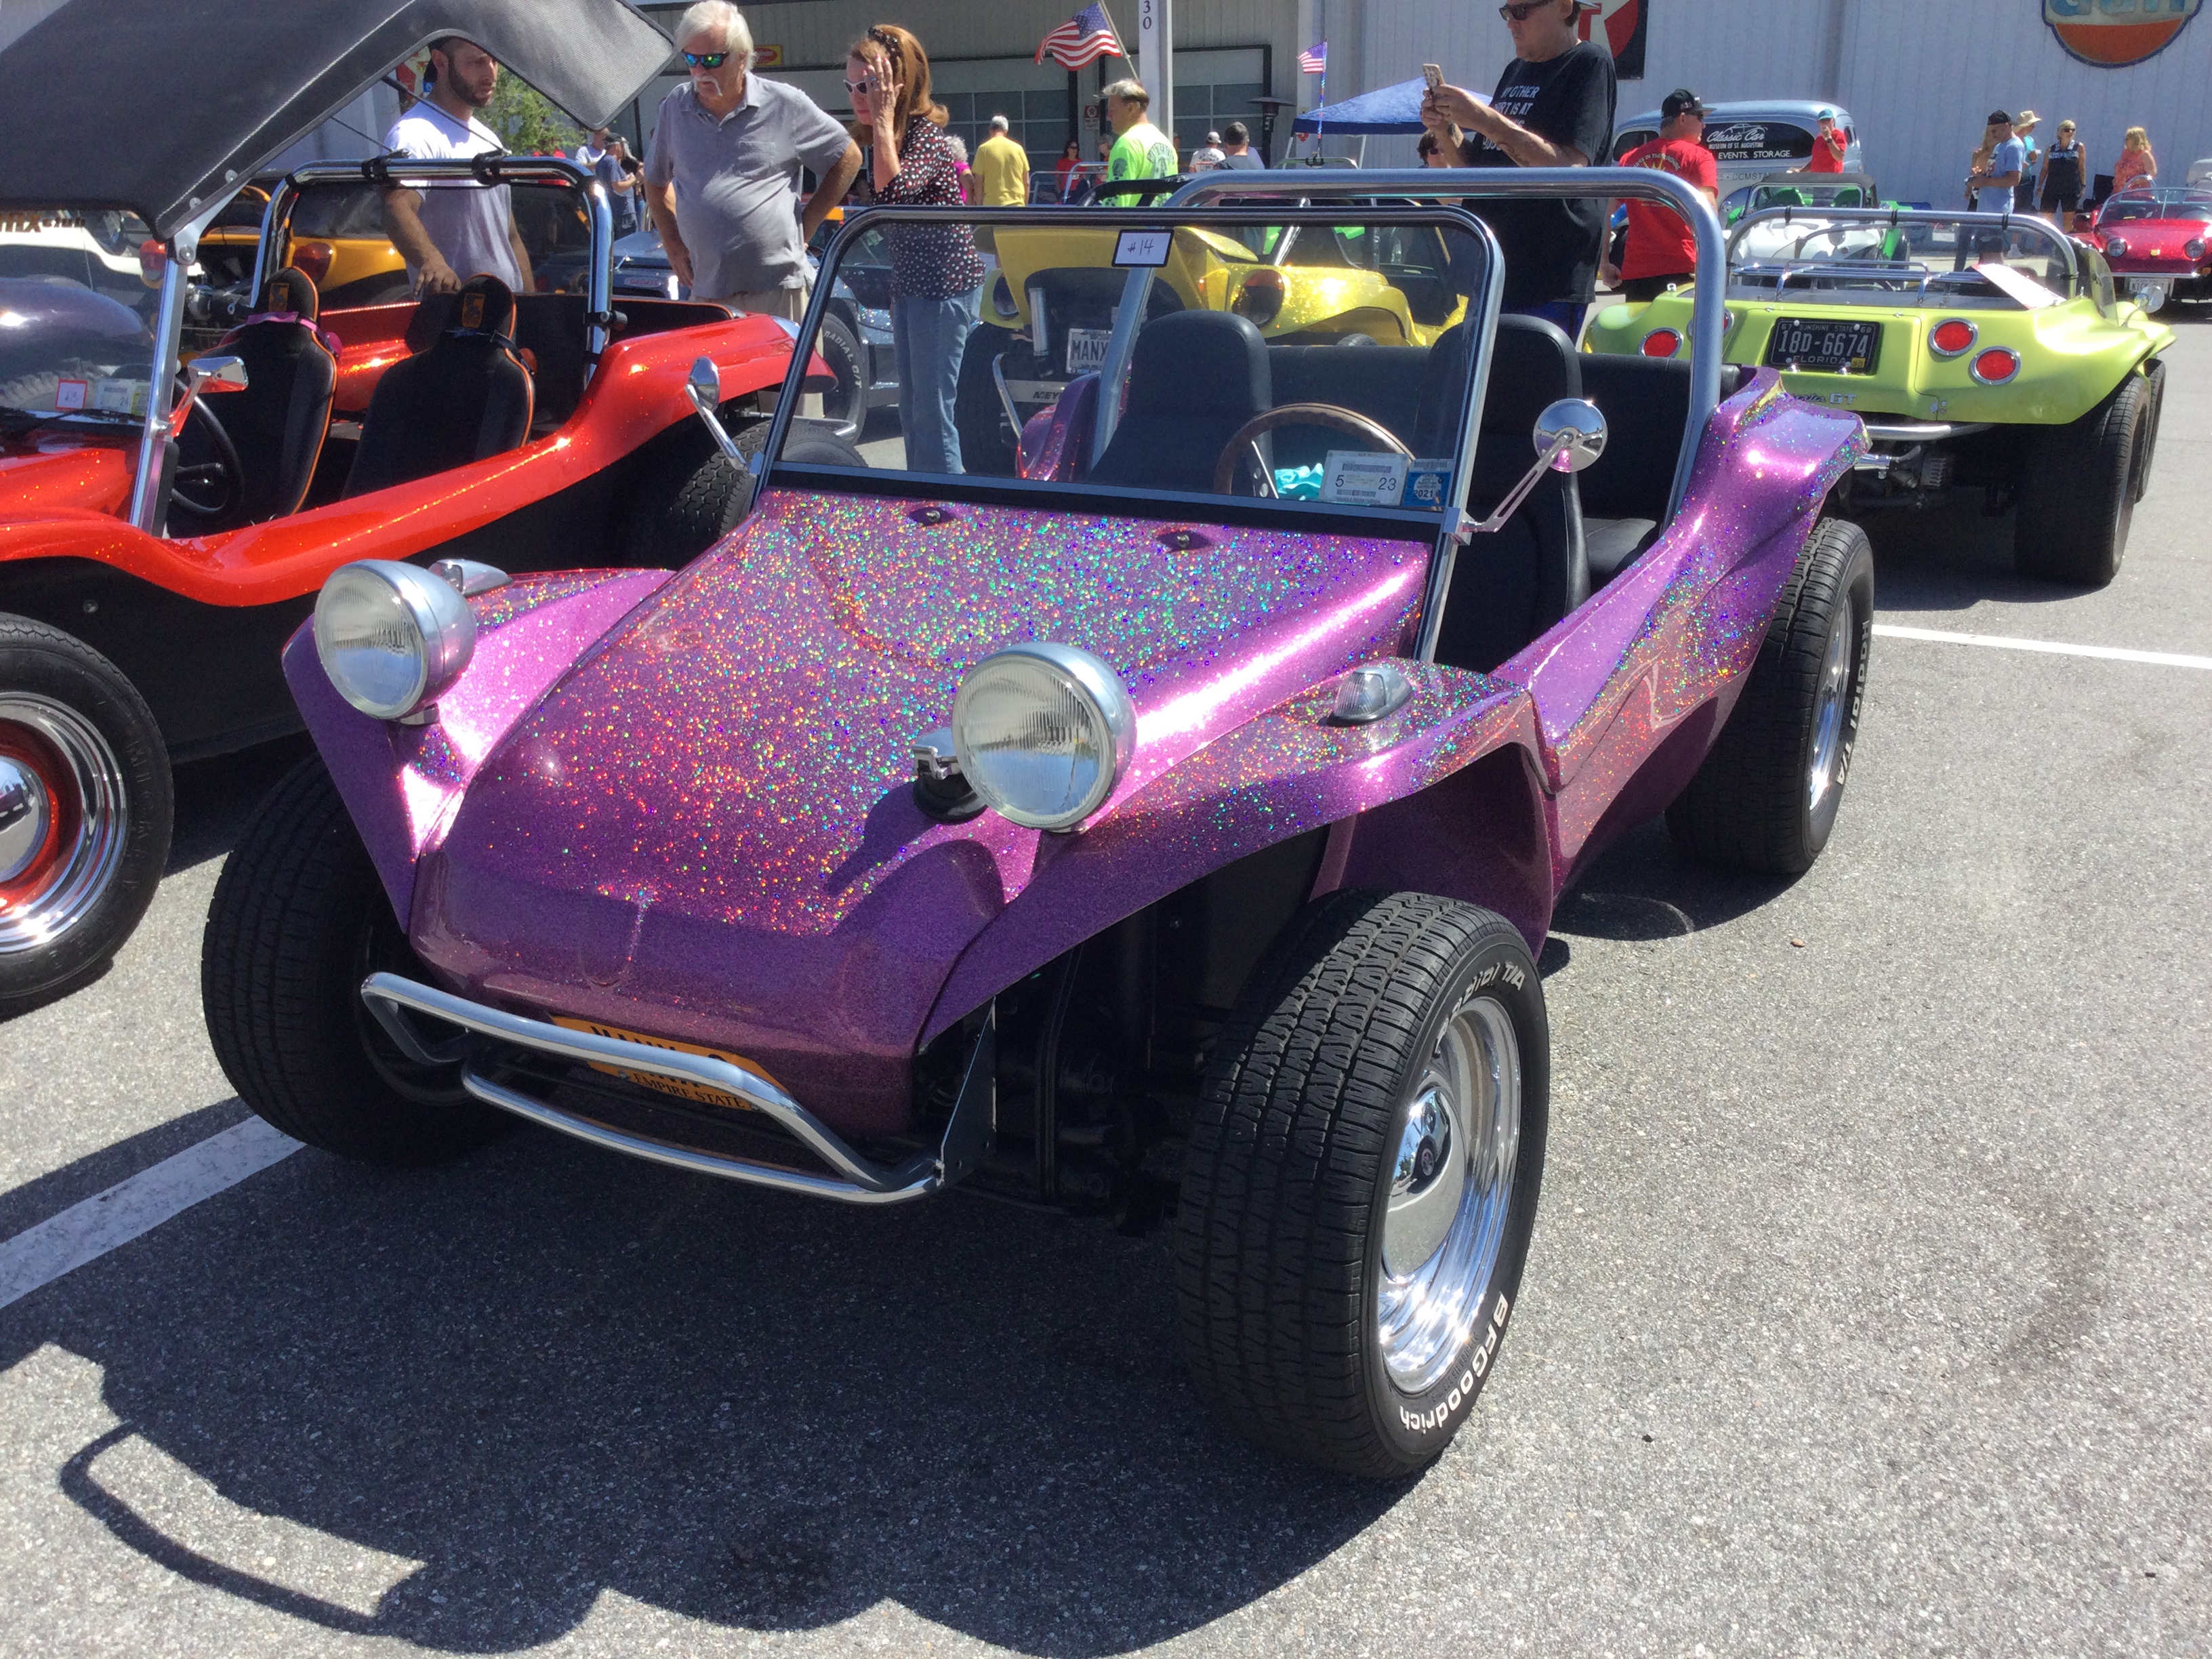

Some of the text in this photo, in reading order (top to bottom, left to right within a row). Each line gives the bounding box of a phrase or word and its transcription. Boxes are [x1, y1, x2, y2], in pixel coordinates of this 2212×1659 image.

[1509, 85, 1540, 98] OTHER
[1519, 102, 1534, 115] AT
[1706, 129, 1765, 142] Classic Car
[1127, 239, 1154, 255] #14
[1778, 330, 1868, 357] 18D-6674
[1793, 356, 1846, 365] FLORIDA
[1829, 393, 1857, 405] GT
[1335, 475, 1397, 491] 5 23
[1414, 489, 1433, 498] 2021
[634, 1073, 746, 1108] EMPIRE STATE
[1399, 1292, 1509, 1435] BFGoodrich
